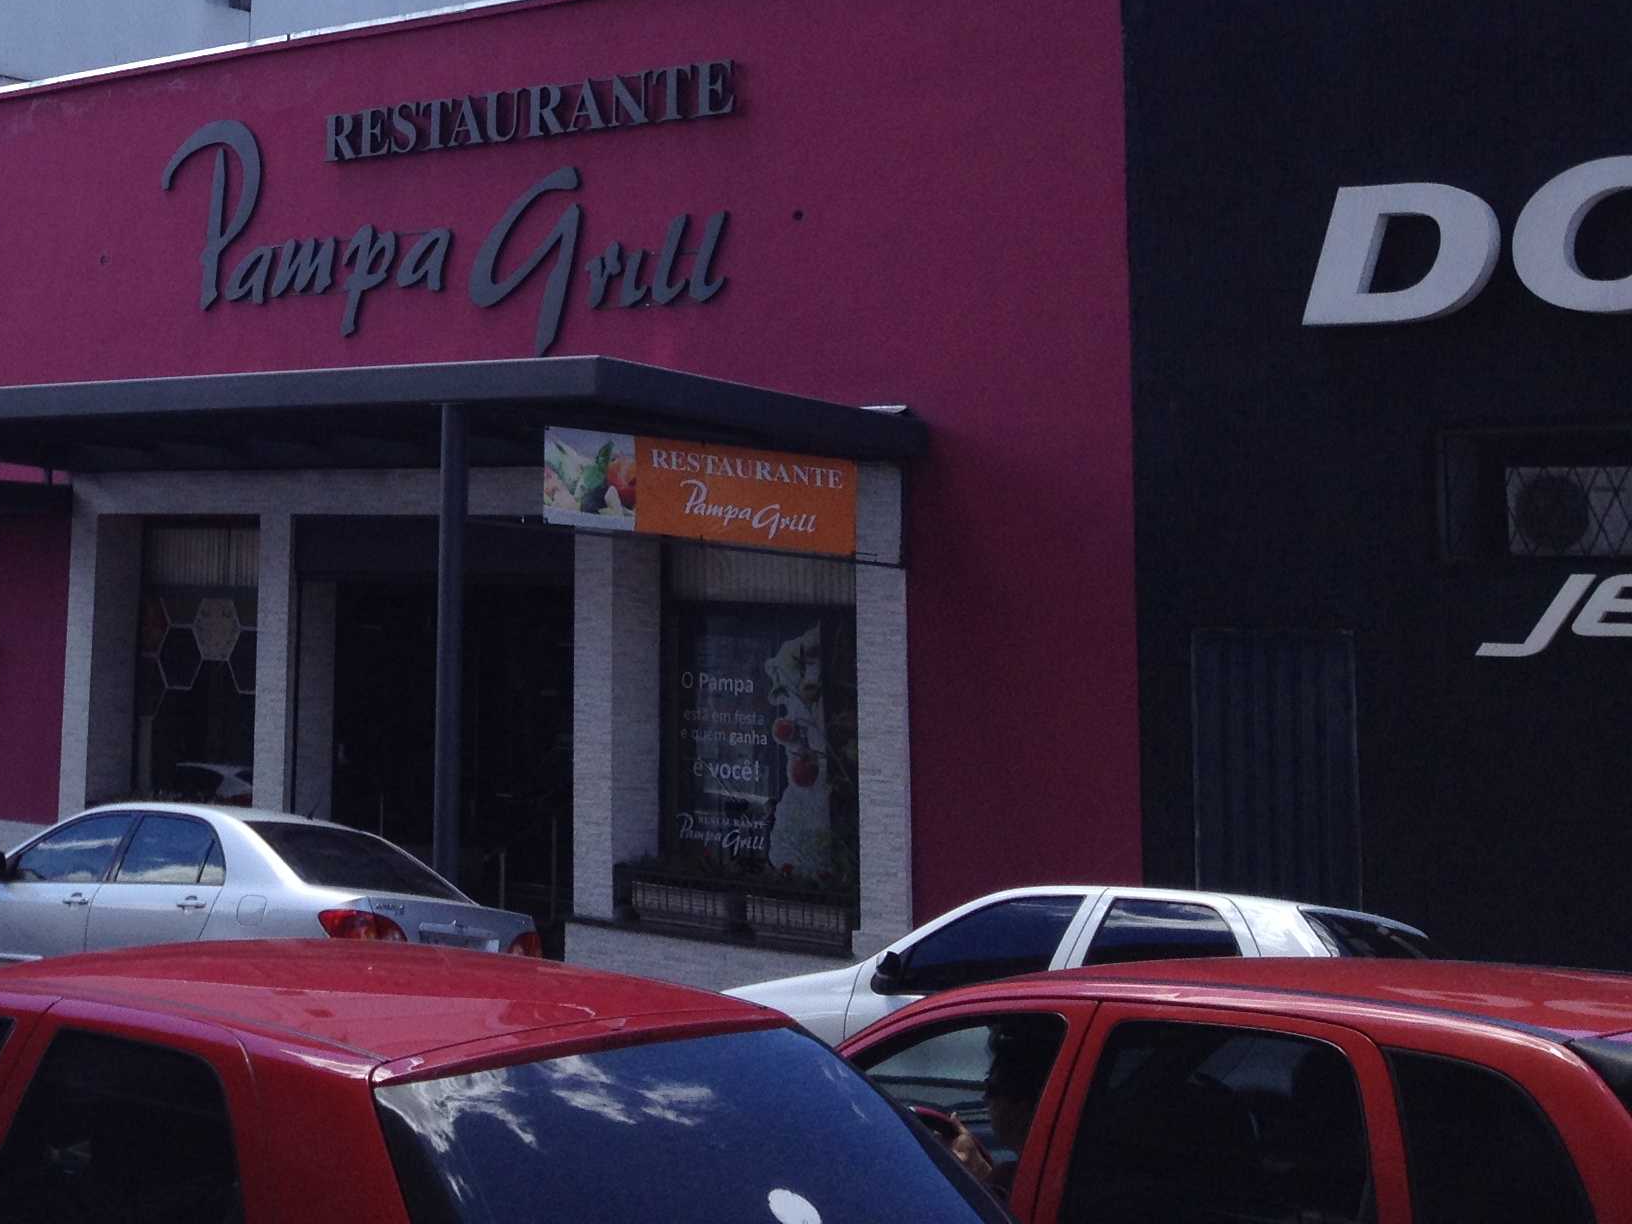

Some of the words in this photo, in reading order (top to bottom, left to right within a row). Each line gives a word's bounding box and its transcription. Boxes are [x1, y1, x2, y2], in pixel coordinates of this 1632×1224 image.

[325, 59, 738, 163] RESTAURANTE
[161, 119, 453, 338] Pampa
[470, 166, 730, 357] Grill
[649, 448, 843, 490] RESTAURANTE
[680, 479, 752, 526] Pampa
[752, 503, 816, 539] Grill
[681, 671, 694, 688] O
[698, 673, 754, 696] Pampa
[729, 729, 767, 746] ganha
[709, 759, 759, 782] você!
[676, 812, 722, 847] Pampa
[722, 827, 765, 856] Grill
